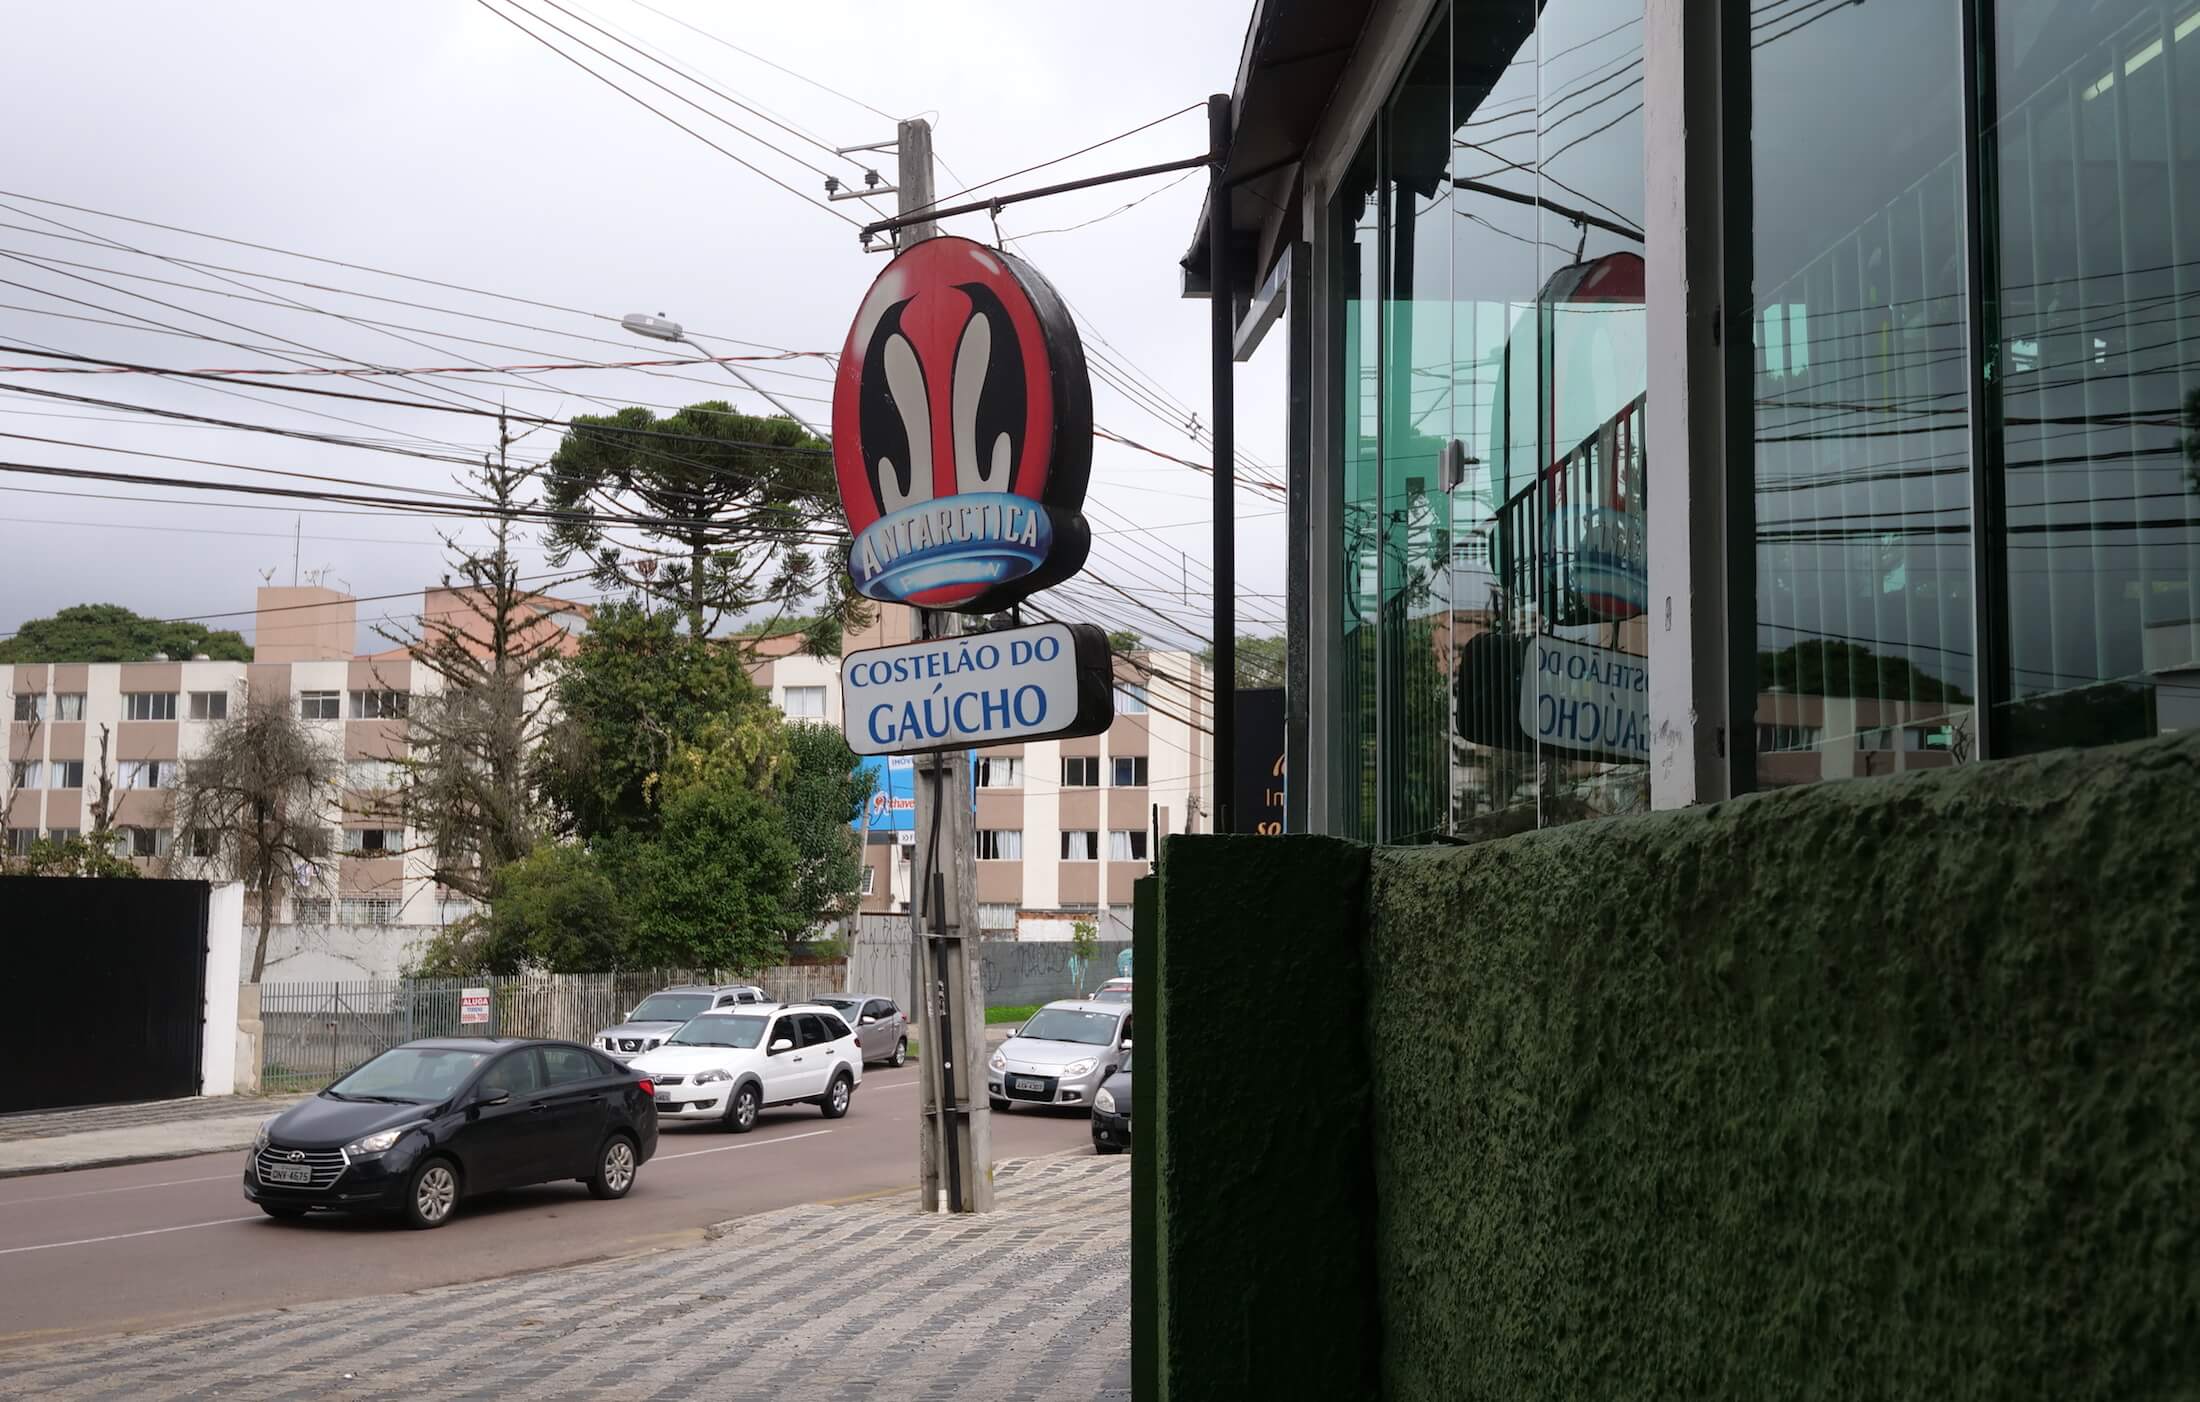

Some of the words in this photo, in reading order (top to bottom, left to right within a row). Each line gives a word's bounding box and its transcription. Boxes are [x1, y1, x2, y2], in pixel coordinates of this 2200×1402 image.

[862, 504, 1038, 581] ANTARCTICA
[849, 641, 1000, 688] COSTELÃO
[1010, 636, 1060, 667] DO
[868, 682, 1048, 745] GAÚCHO
[463, 997, 489, 1006] ALUGA
